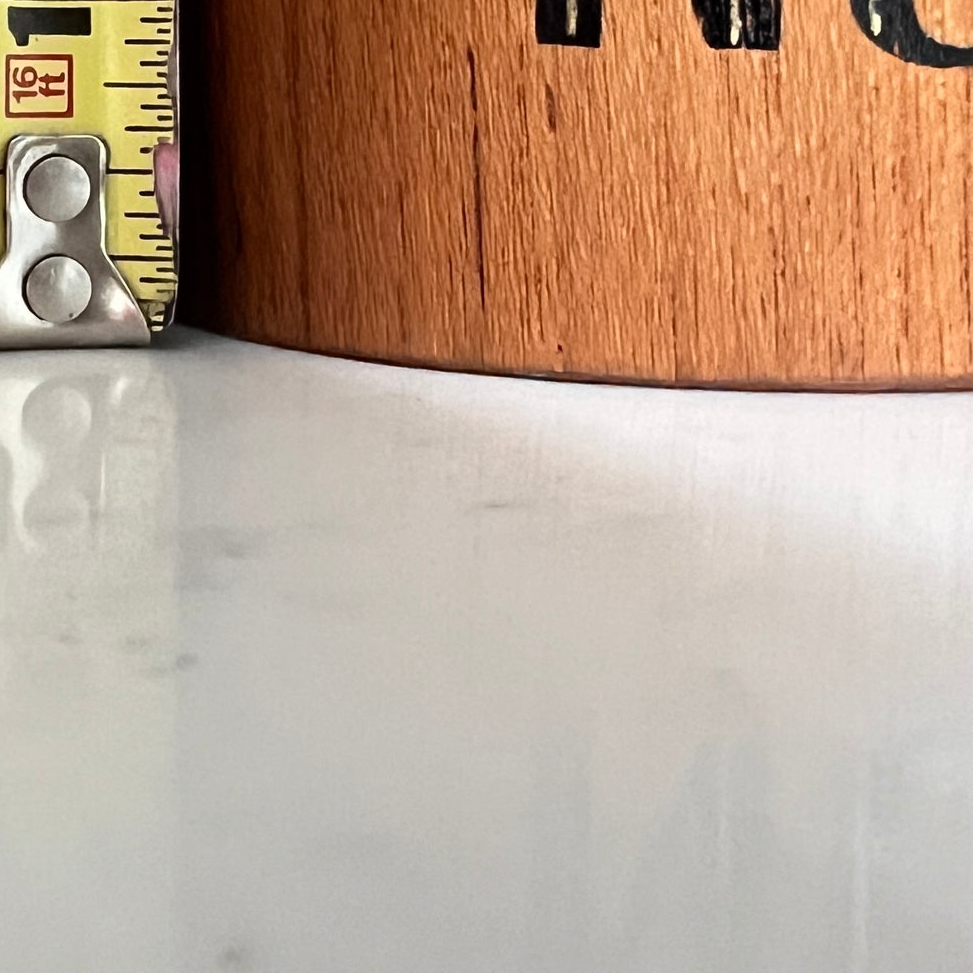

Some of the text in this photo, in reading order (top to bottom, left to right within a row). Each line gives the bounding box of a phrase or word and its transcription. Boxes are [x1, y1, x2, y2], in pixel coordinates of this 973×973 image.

[7, 6, 92, 46] 1
[12, 65, 39, 104] 16
[38, 71, 66, 98] ft
